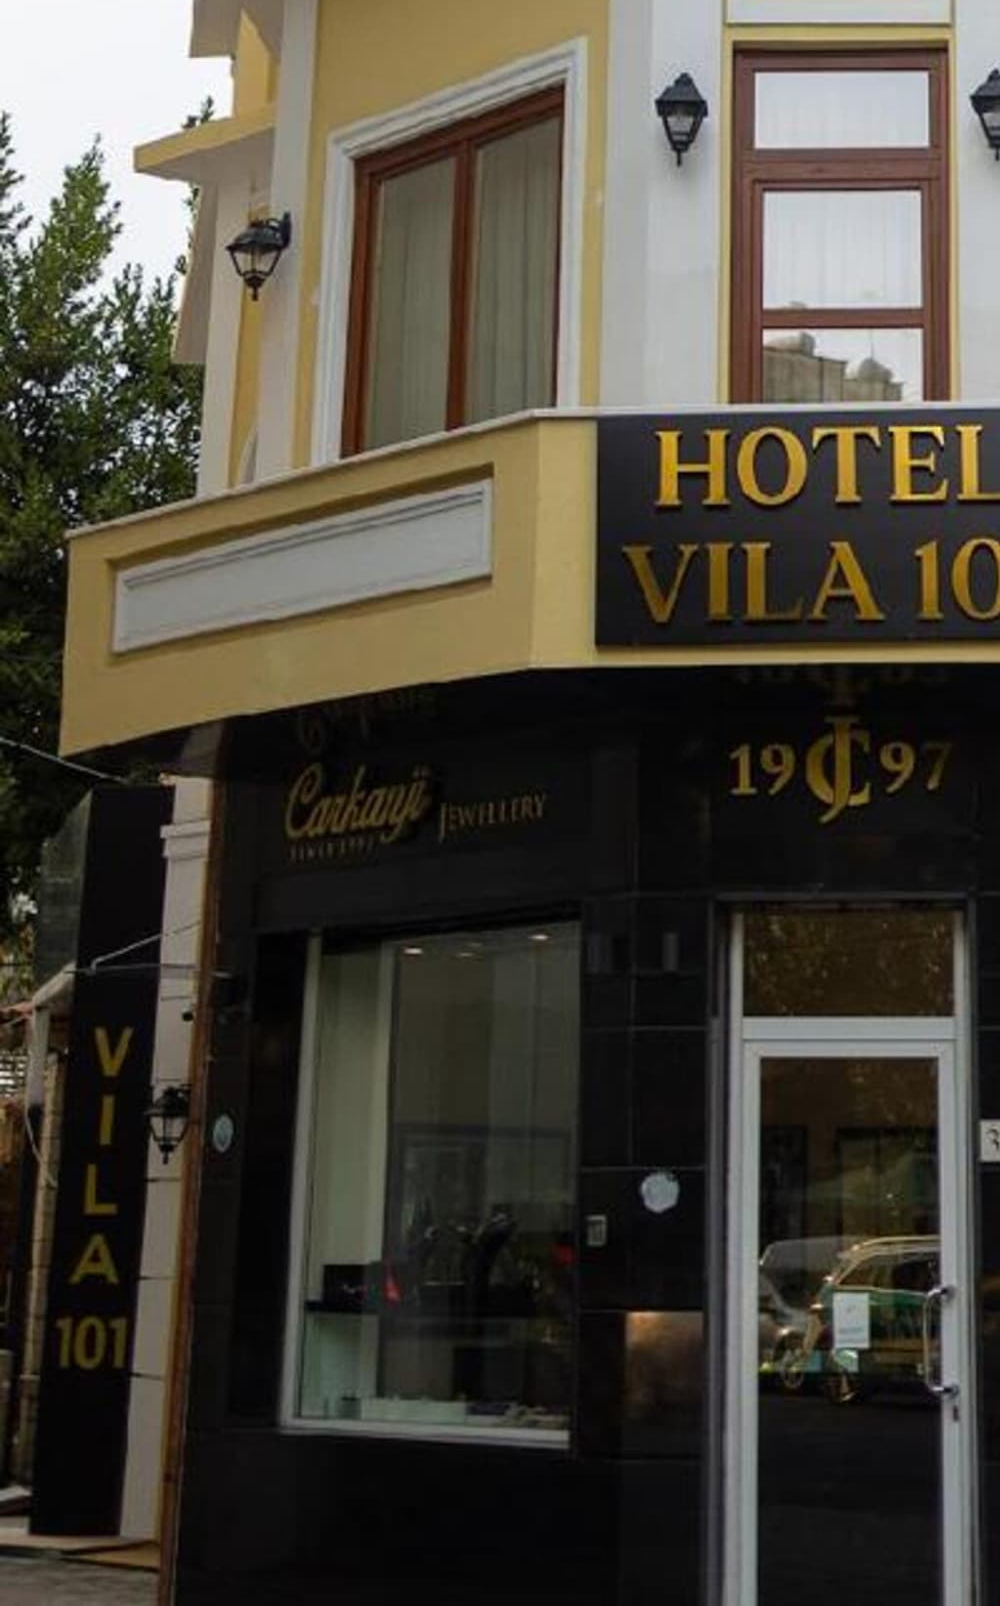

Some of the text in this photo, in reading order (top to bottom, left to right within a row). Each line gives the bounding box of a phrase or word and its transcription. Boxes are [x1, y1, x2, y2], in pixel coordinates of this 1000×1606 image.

[622, 540, 887, 625] VILA
[69, 1025, 134, 1286] VILA
[55, 1315, 129, 1371] 101
